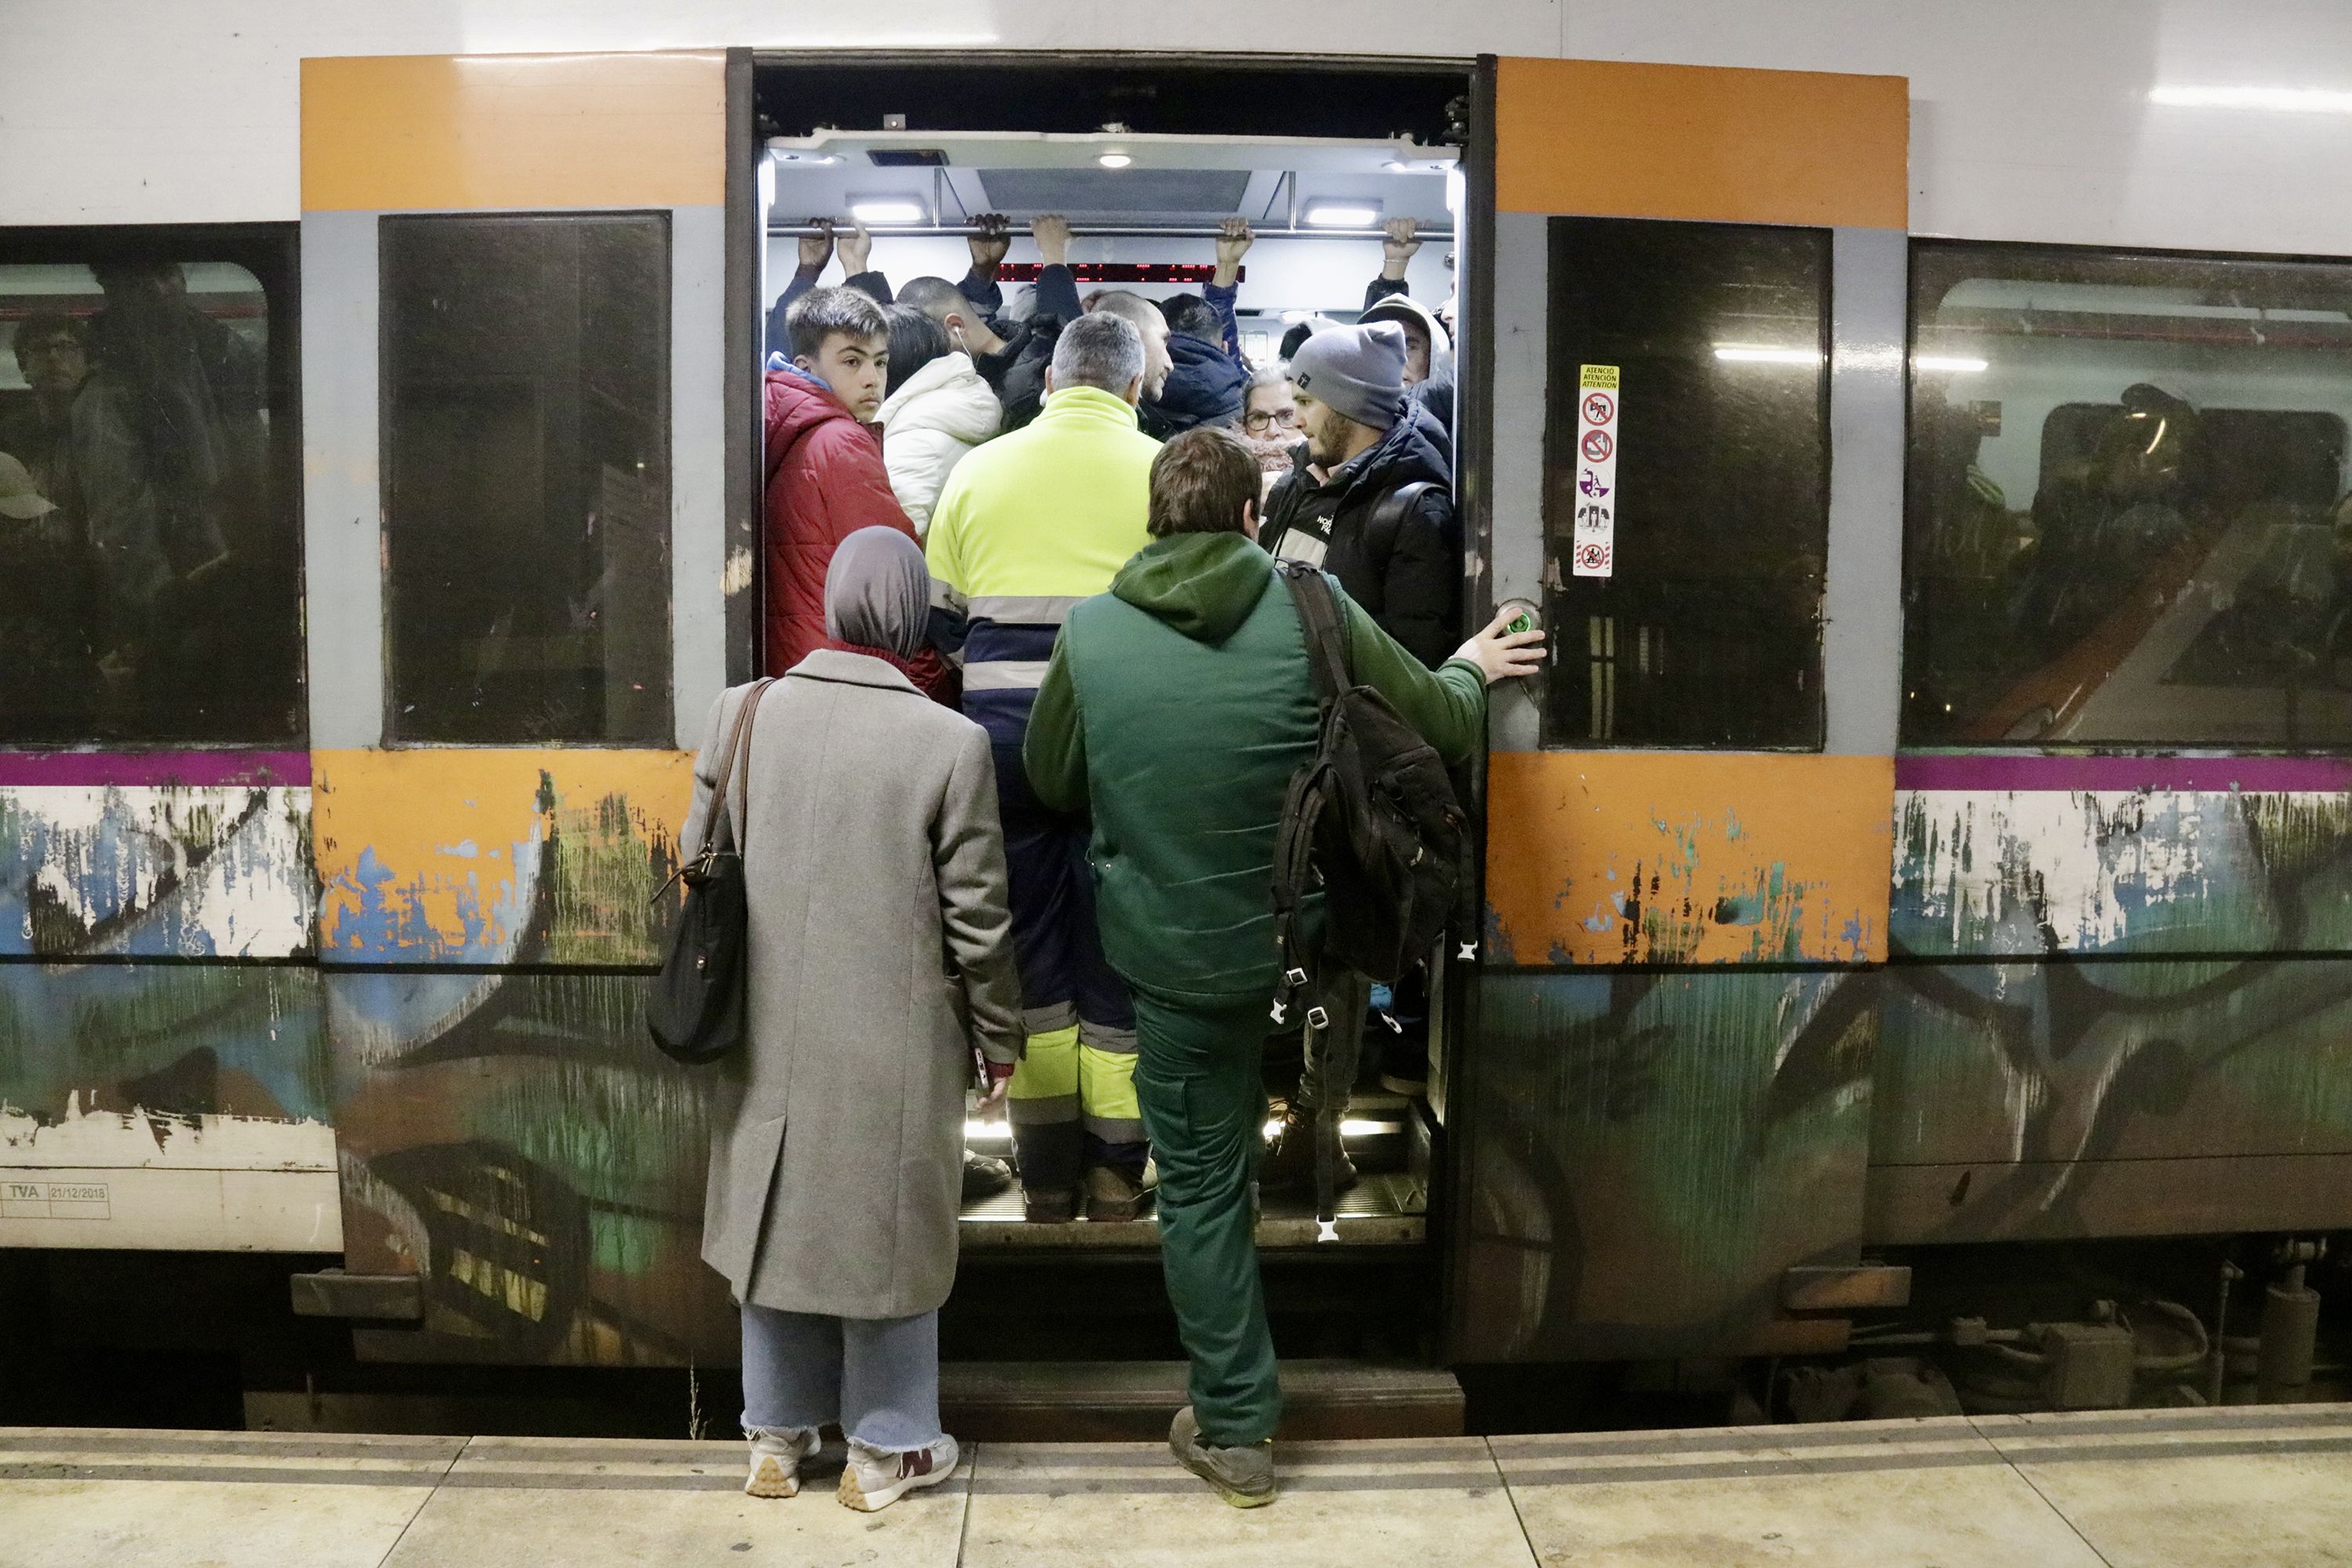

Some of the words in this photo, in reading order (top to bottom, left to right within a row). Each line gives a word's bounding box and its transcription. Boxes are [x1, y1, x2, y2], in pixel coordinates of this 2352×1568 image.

[1317, 515, 1333, 528] NOR
[9, 1185, 39, 1197] TVA
[51, 1188, 105, 1198] 21/12/2018
